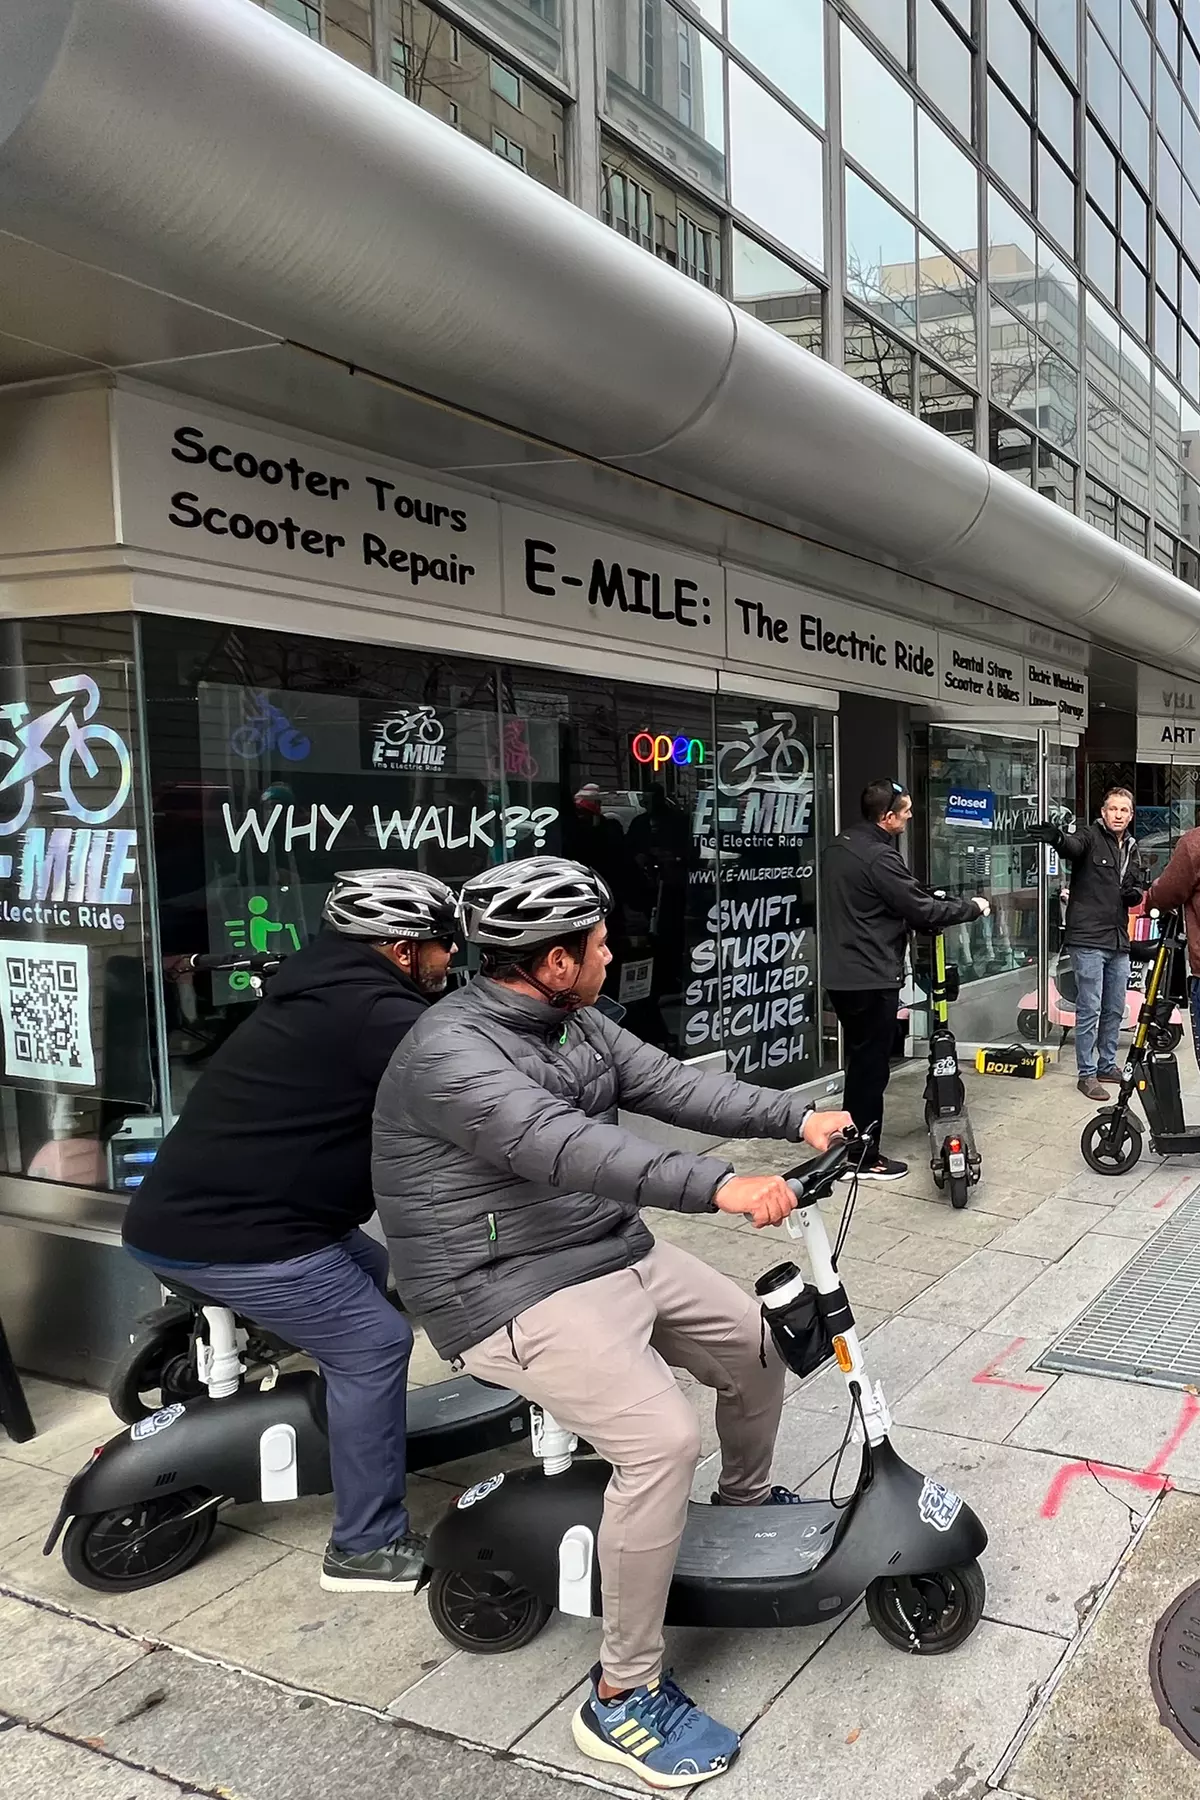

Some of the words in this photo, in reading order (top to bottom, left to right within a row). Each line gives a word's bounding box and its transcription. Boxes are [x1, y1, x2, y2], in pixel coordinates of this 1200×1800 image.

[171, 426, 350, 500] Scooter
[365, 476, 468, 532] Tours
[168, 491, 346, 558] Scooter
[362, 532, 476, 585] Repair
[524, 538, 712, 628] E-MILE:
[734, 597, 790, 644] The
[799, 613, 888, 667] Electric
[894, 639, 936, 678] Ride
[952, 650, 984, 674] Rental
[987, 660, 1013, 681] Store
[944, 671, 984, 695] Scooter
[986, 680, 995, 698] &
[997, 683, 1020, 703] Bikes
[372, 741, 447, 765] E-MILE
[632, 733, 704, 771] open
[1161, 726, 1196, 744] ART
[692, 790, 813, 834] E-MILE
[948, 795, 987, 809] Closed
[222, 802, 354, 853] WHY
[372, 803, 560, 850] WALK??
[692, 834, 717, 847] The
[722, 834, 774, 848] Electric
[778, 836, 804, 847] Ride
[78, 906, 125, 930] Ride
[706, 894, 801, 933] SWIFT.
[690, 930, 806, 973] STURDY.
[685, 964, 813, 1006] STERILIZED.
[685, 993, 811, 1046] SECURE.
[727, 1033, 809, 1074] YLISH.
[986, 1062, 1018, 1074] BOLT
